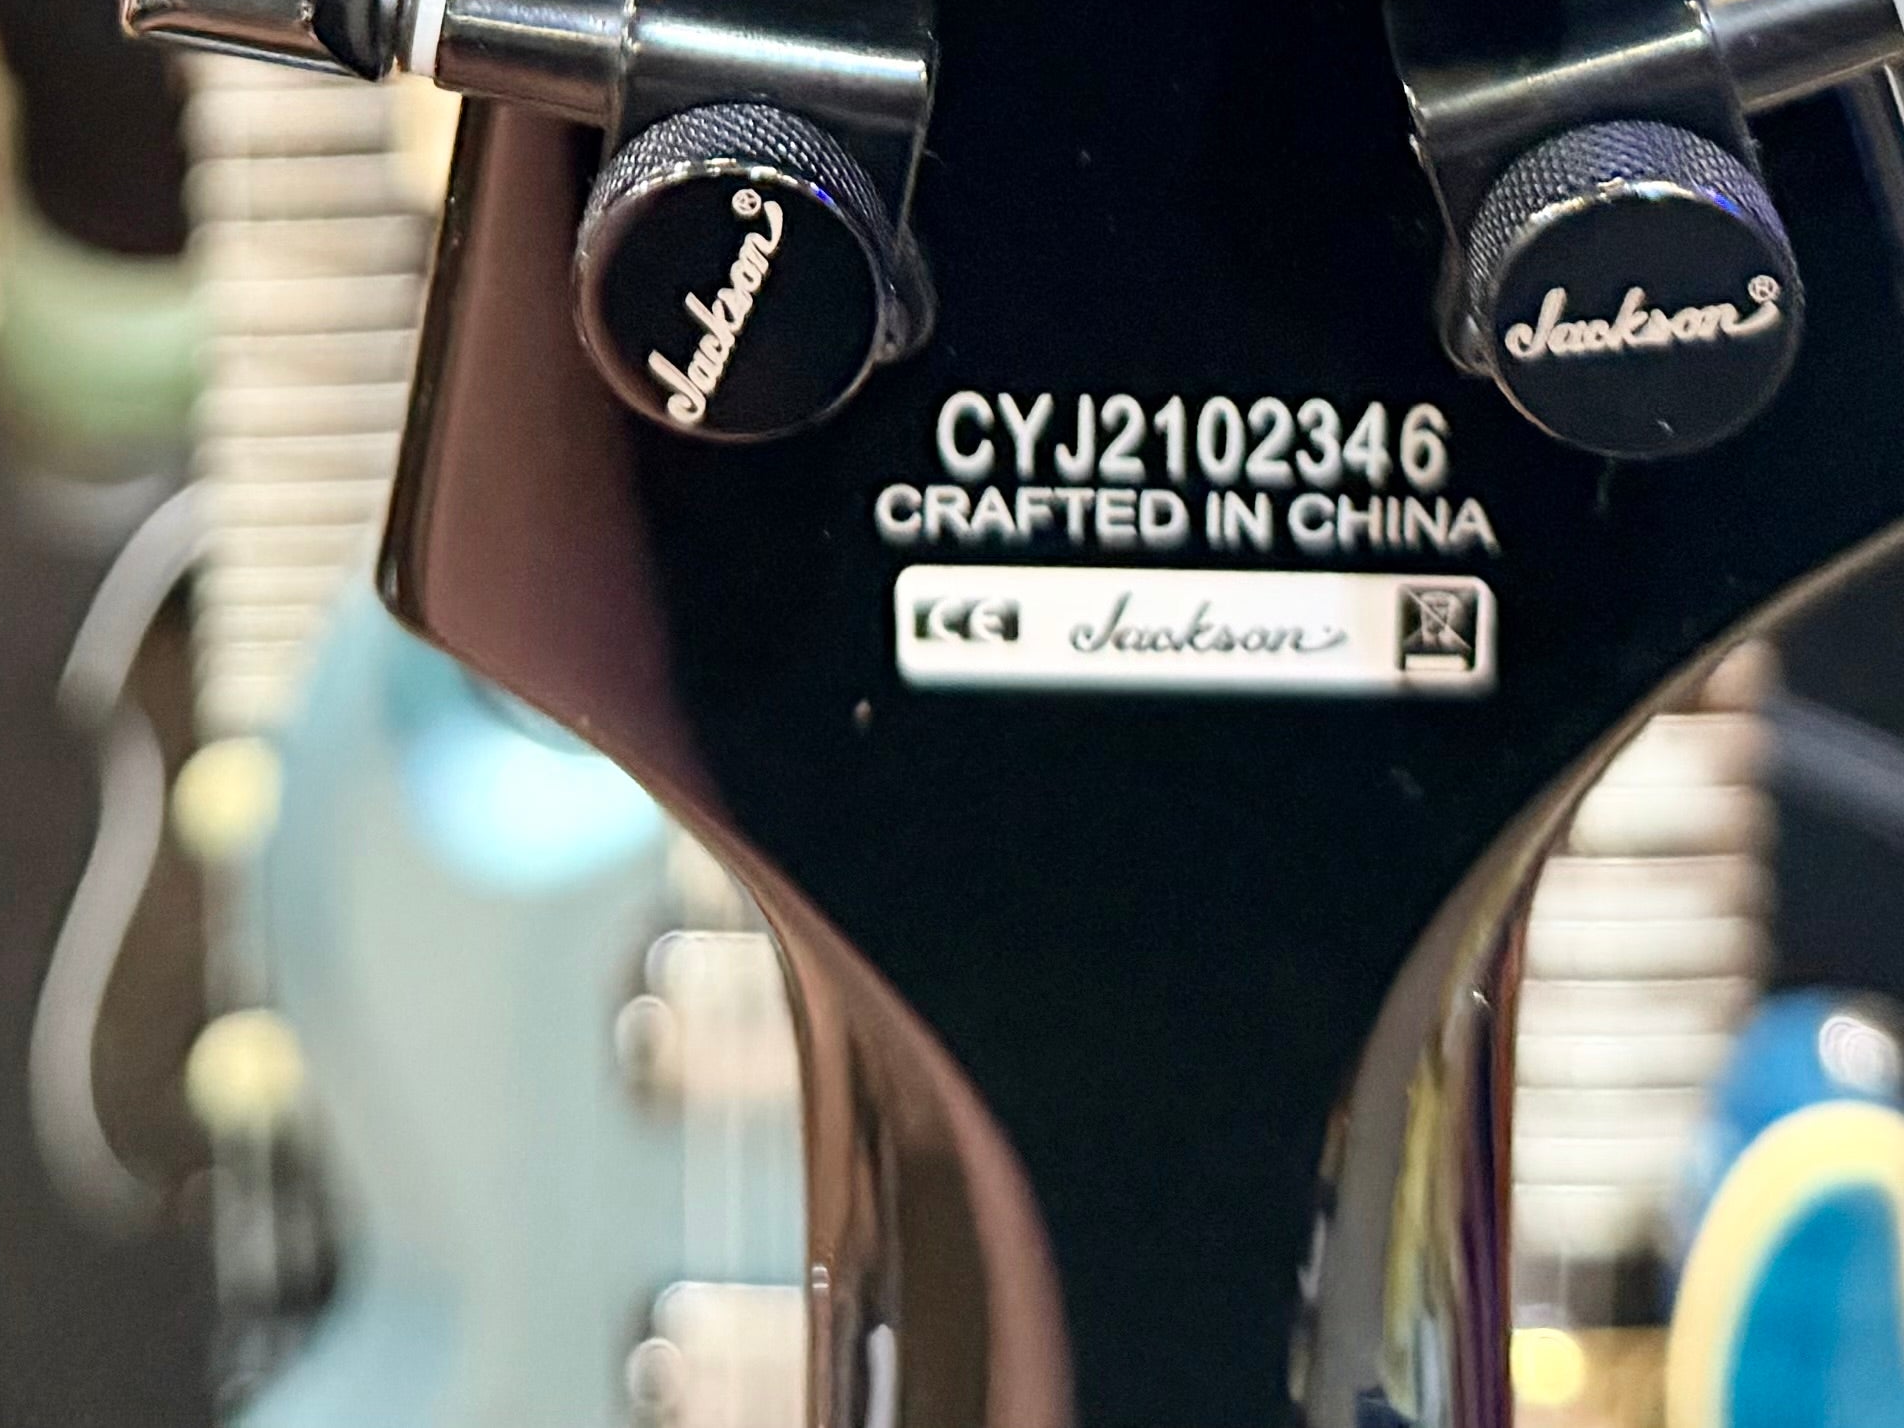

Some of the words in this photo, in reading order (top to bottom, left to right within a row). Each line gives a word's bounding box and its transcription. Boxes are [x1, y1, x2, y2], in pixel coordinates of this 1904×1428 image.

[935, 389, 1450, 489] CYJ2102346
[873, 482, 1190, 544] CRAFTED
[1203, 490, 1274, 546] IN
[1286, 491, 1499, 553] CHINA
